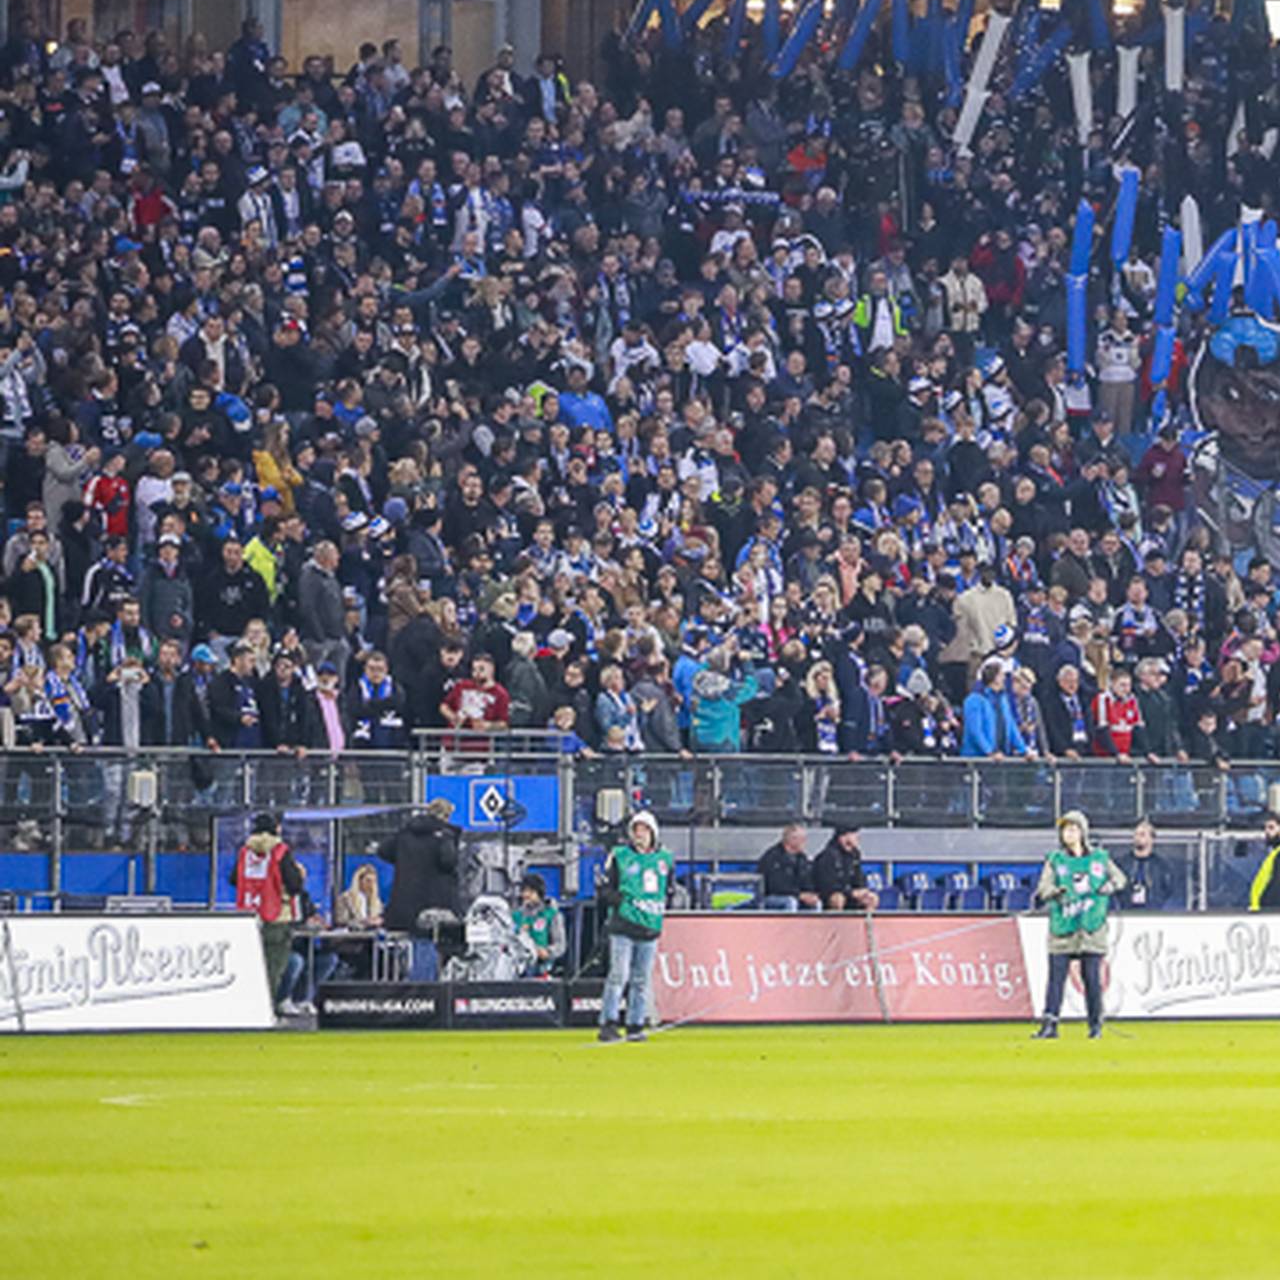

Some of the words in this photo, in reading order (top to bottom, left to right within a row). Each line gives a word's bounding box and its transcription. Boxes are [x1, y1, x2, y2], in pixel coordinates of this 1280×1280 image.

[87, 922, 232, 988] Pilsener
[661, 951, 733, 989] Und
[745, 954, 831, 1003] jetzt
[845, 955, 899, 989] ein
[911, 951, 1024, 1001] König.
[1135, 928, 1233, 997] König
